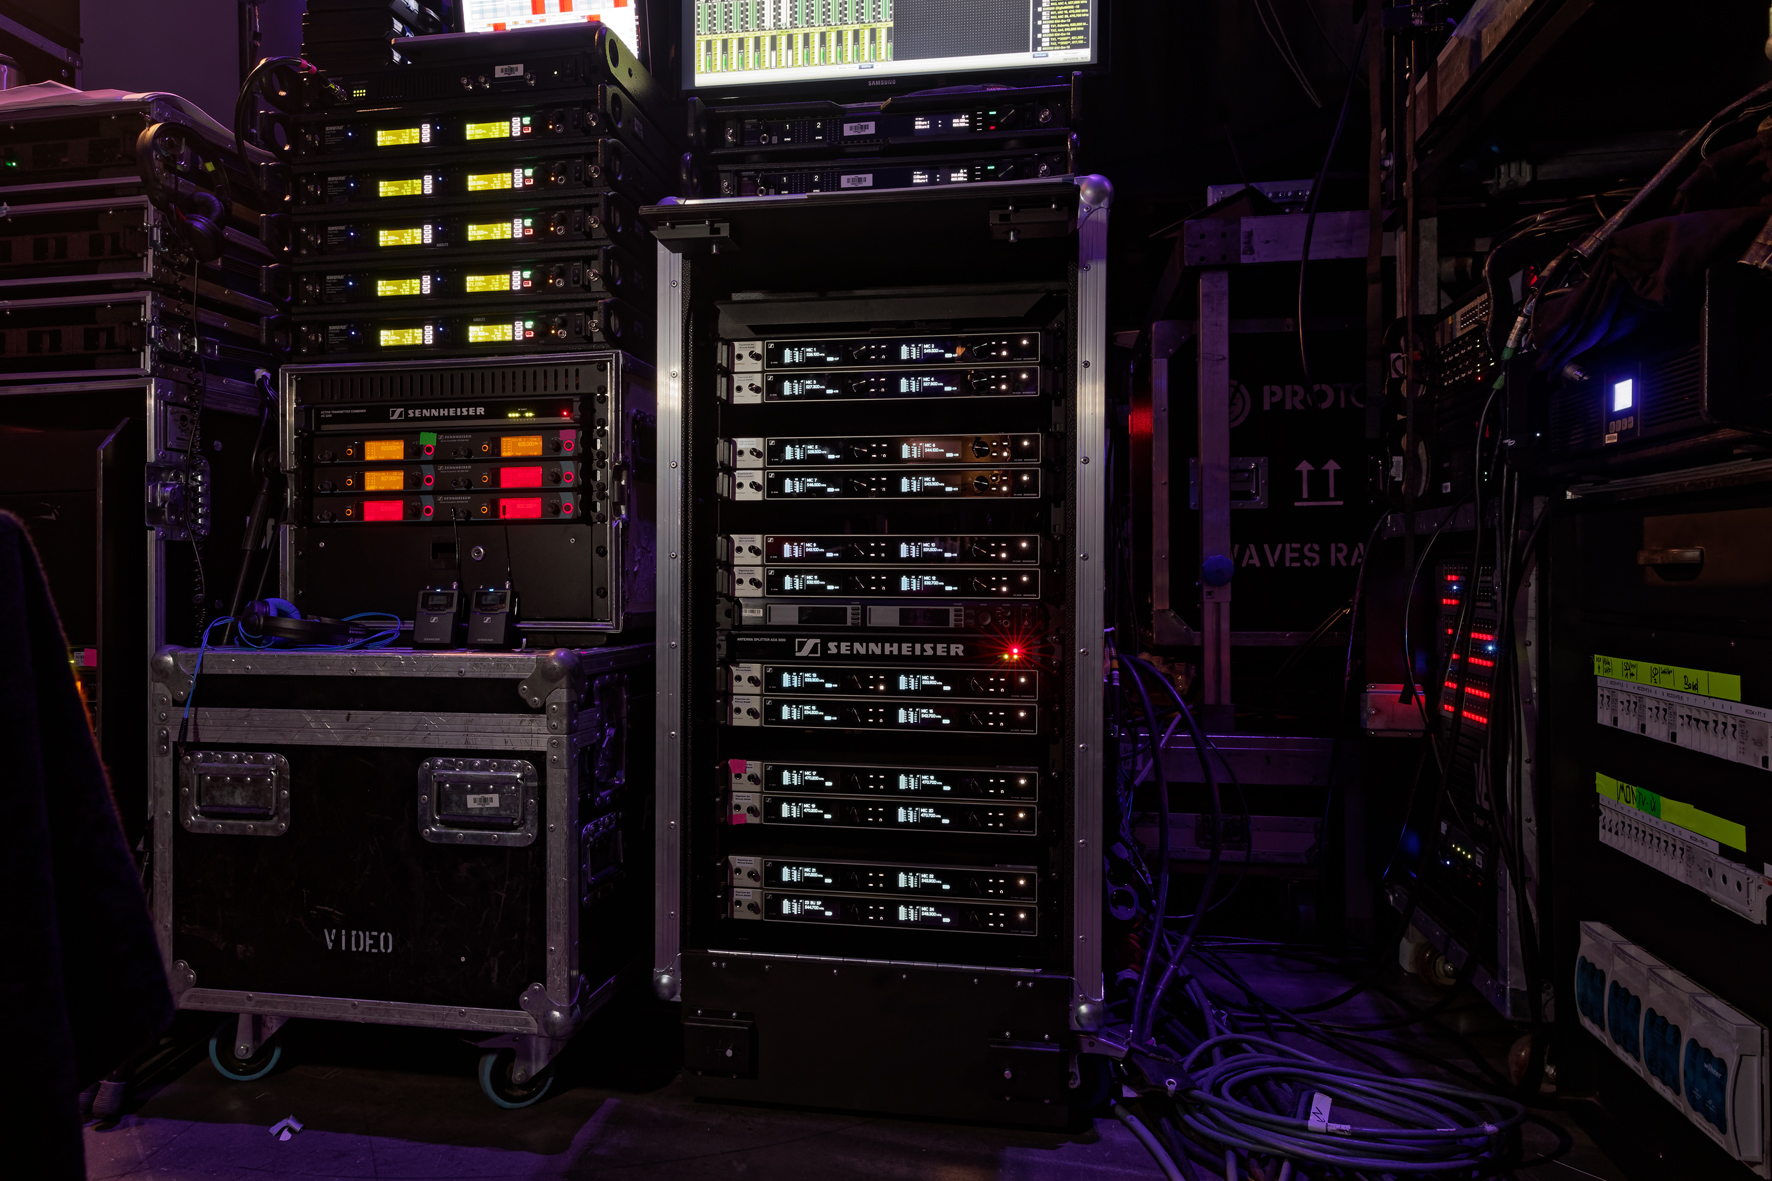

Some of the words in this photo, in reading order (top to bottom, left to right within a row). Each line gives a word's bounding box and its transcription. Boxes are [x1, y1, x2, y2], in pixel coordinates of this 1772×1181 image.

[408, 407, 485, 417] SENNHEISER
[1231, 543, 1320, 568] AVES
[828, 642, 964, 656] SENNHEISER
[324, 929, 392, 953] VIDEO
